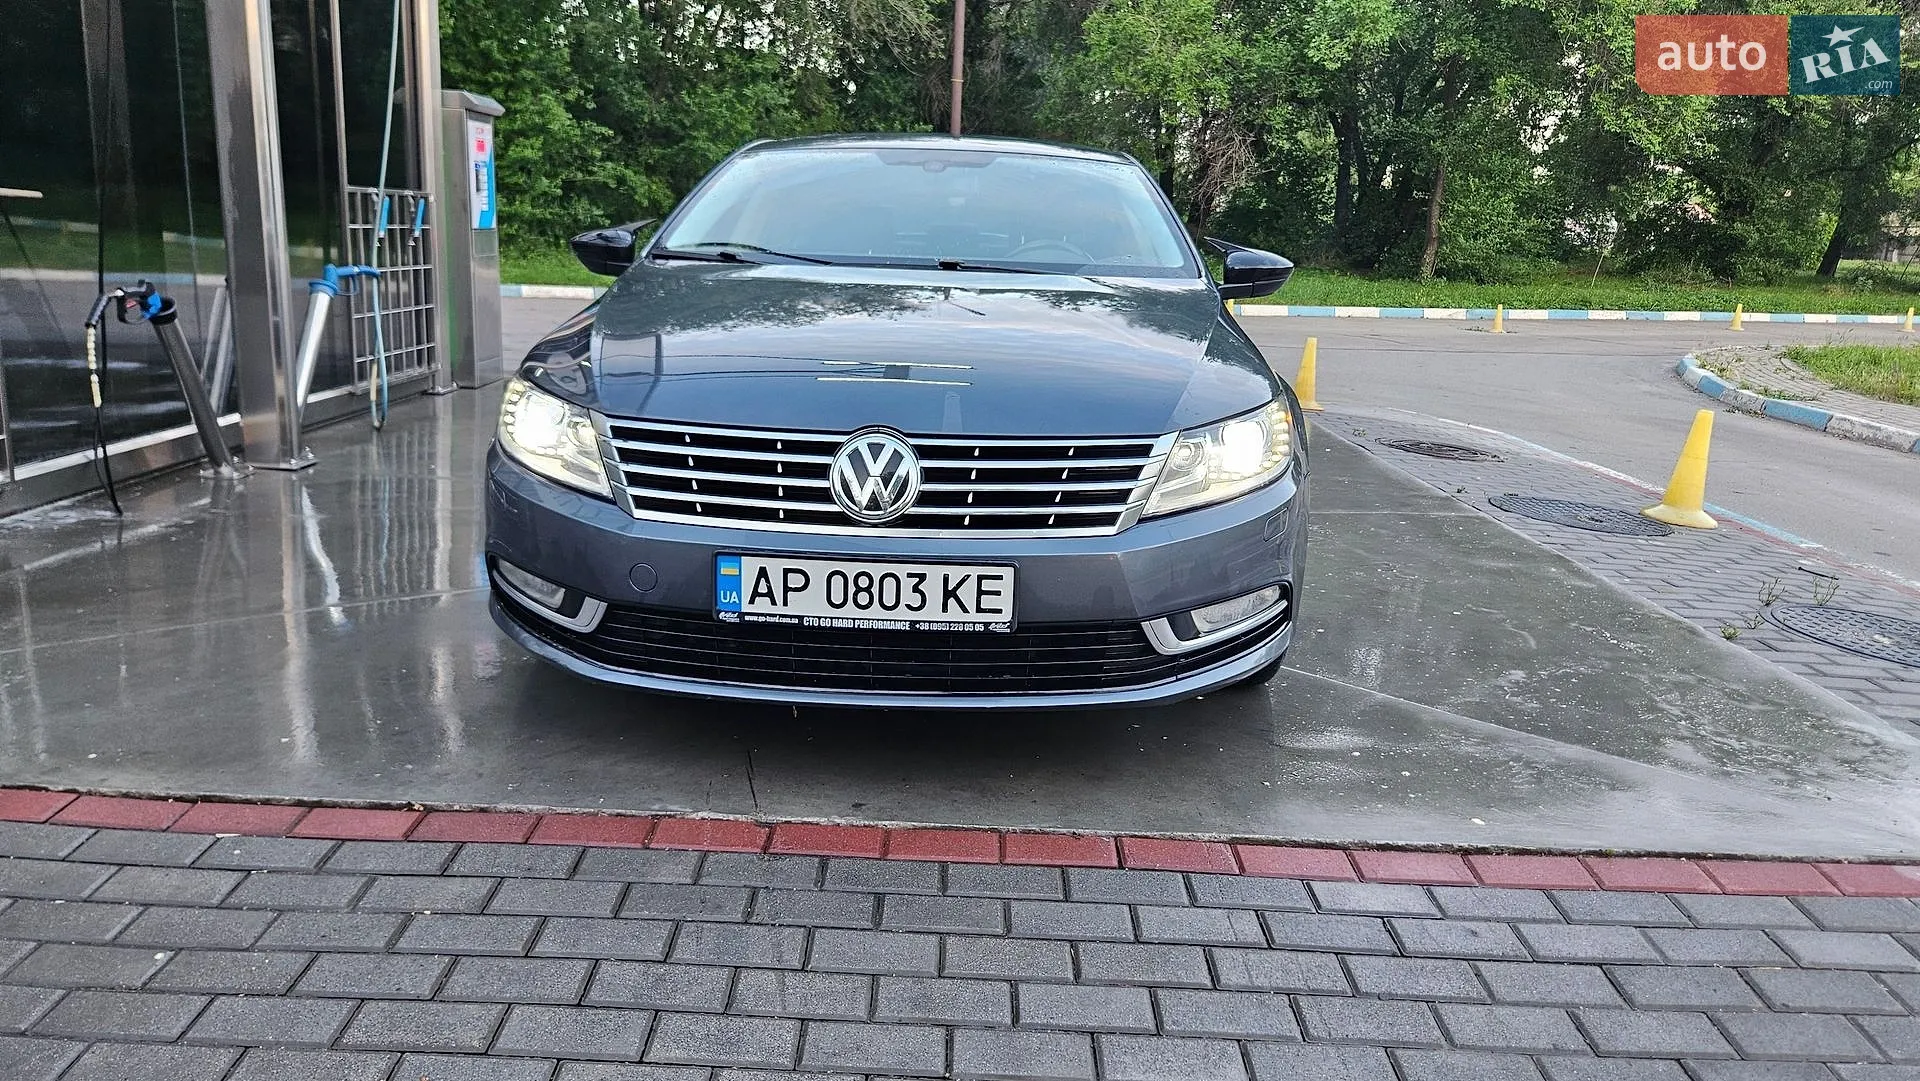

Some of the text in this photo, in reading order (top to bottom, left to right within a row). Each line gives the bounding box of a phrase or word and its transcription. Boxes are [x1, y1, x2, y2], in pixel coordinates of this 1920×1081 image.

[720, 590, 740, 604] UA
[748, 566, 1004, 614] AP 0803 KE
[820, 617, 831, 627] GO
[832, 618, 854, 628] HARD
[855, 619, 911, 630] PERFORMANCE
